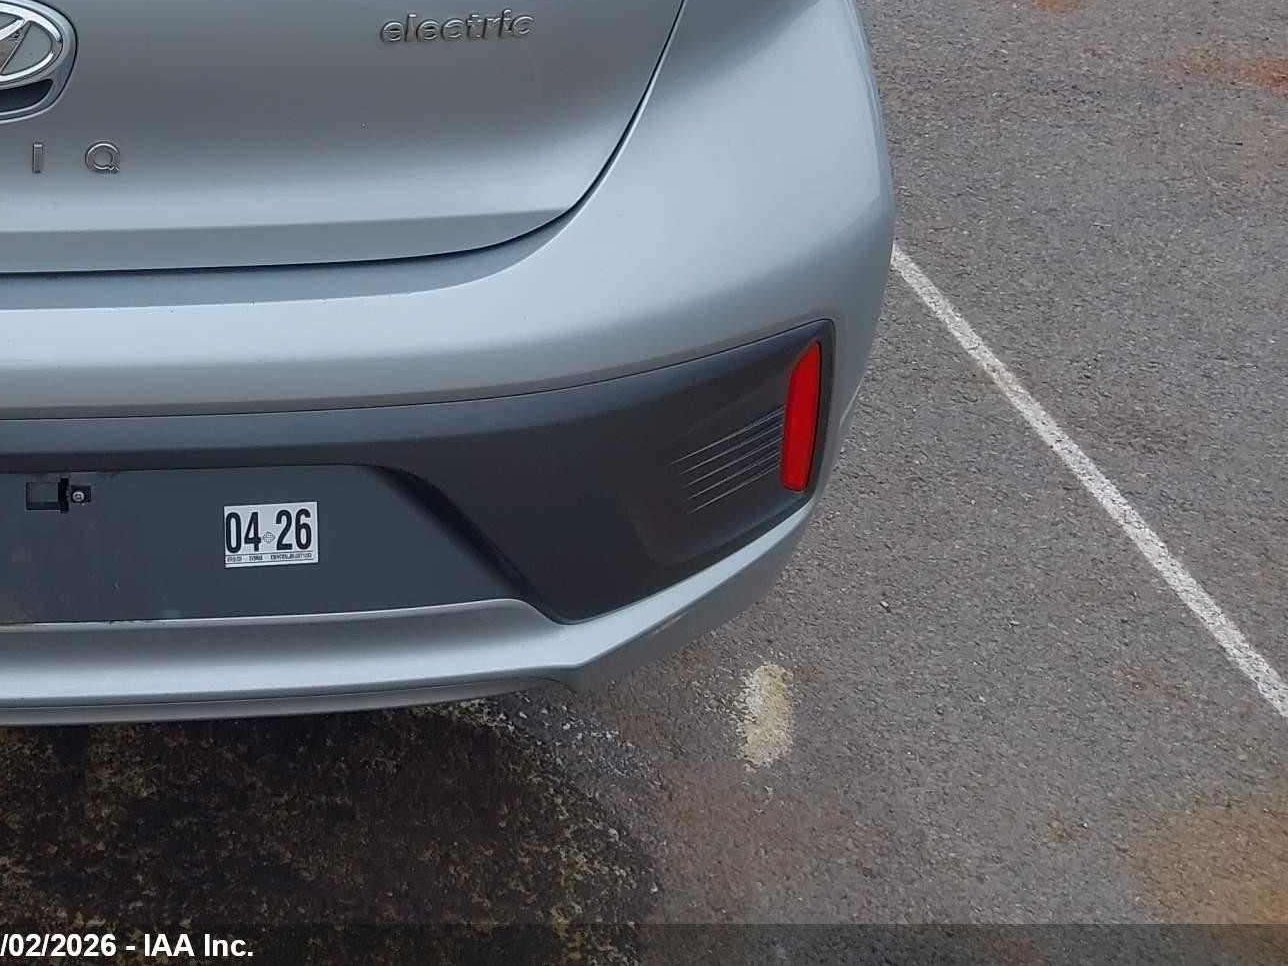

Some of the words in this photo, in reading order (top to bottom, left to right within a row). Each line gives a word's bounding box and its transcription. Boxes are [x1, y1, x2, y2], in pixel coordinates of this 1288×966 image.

[380, 8, 533, 43] electric
[225, 511, 261, 554] 04
[275, 508, 312, 551] 26
